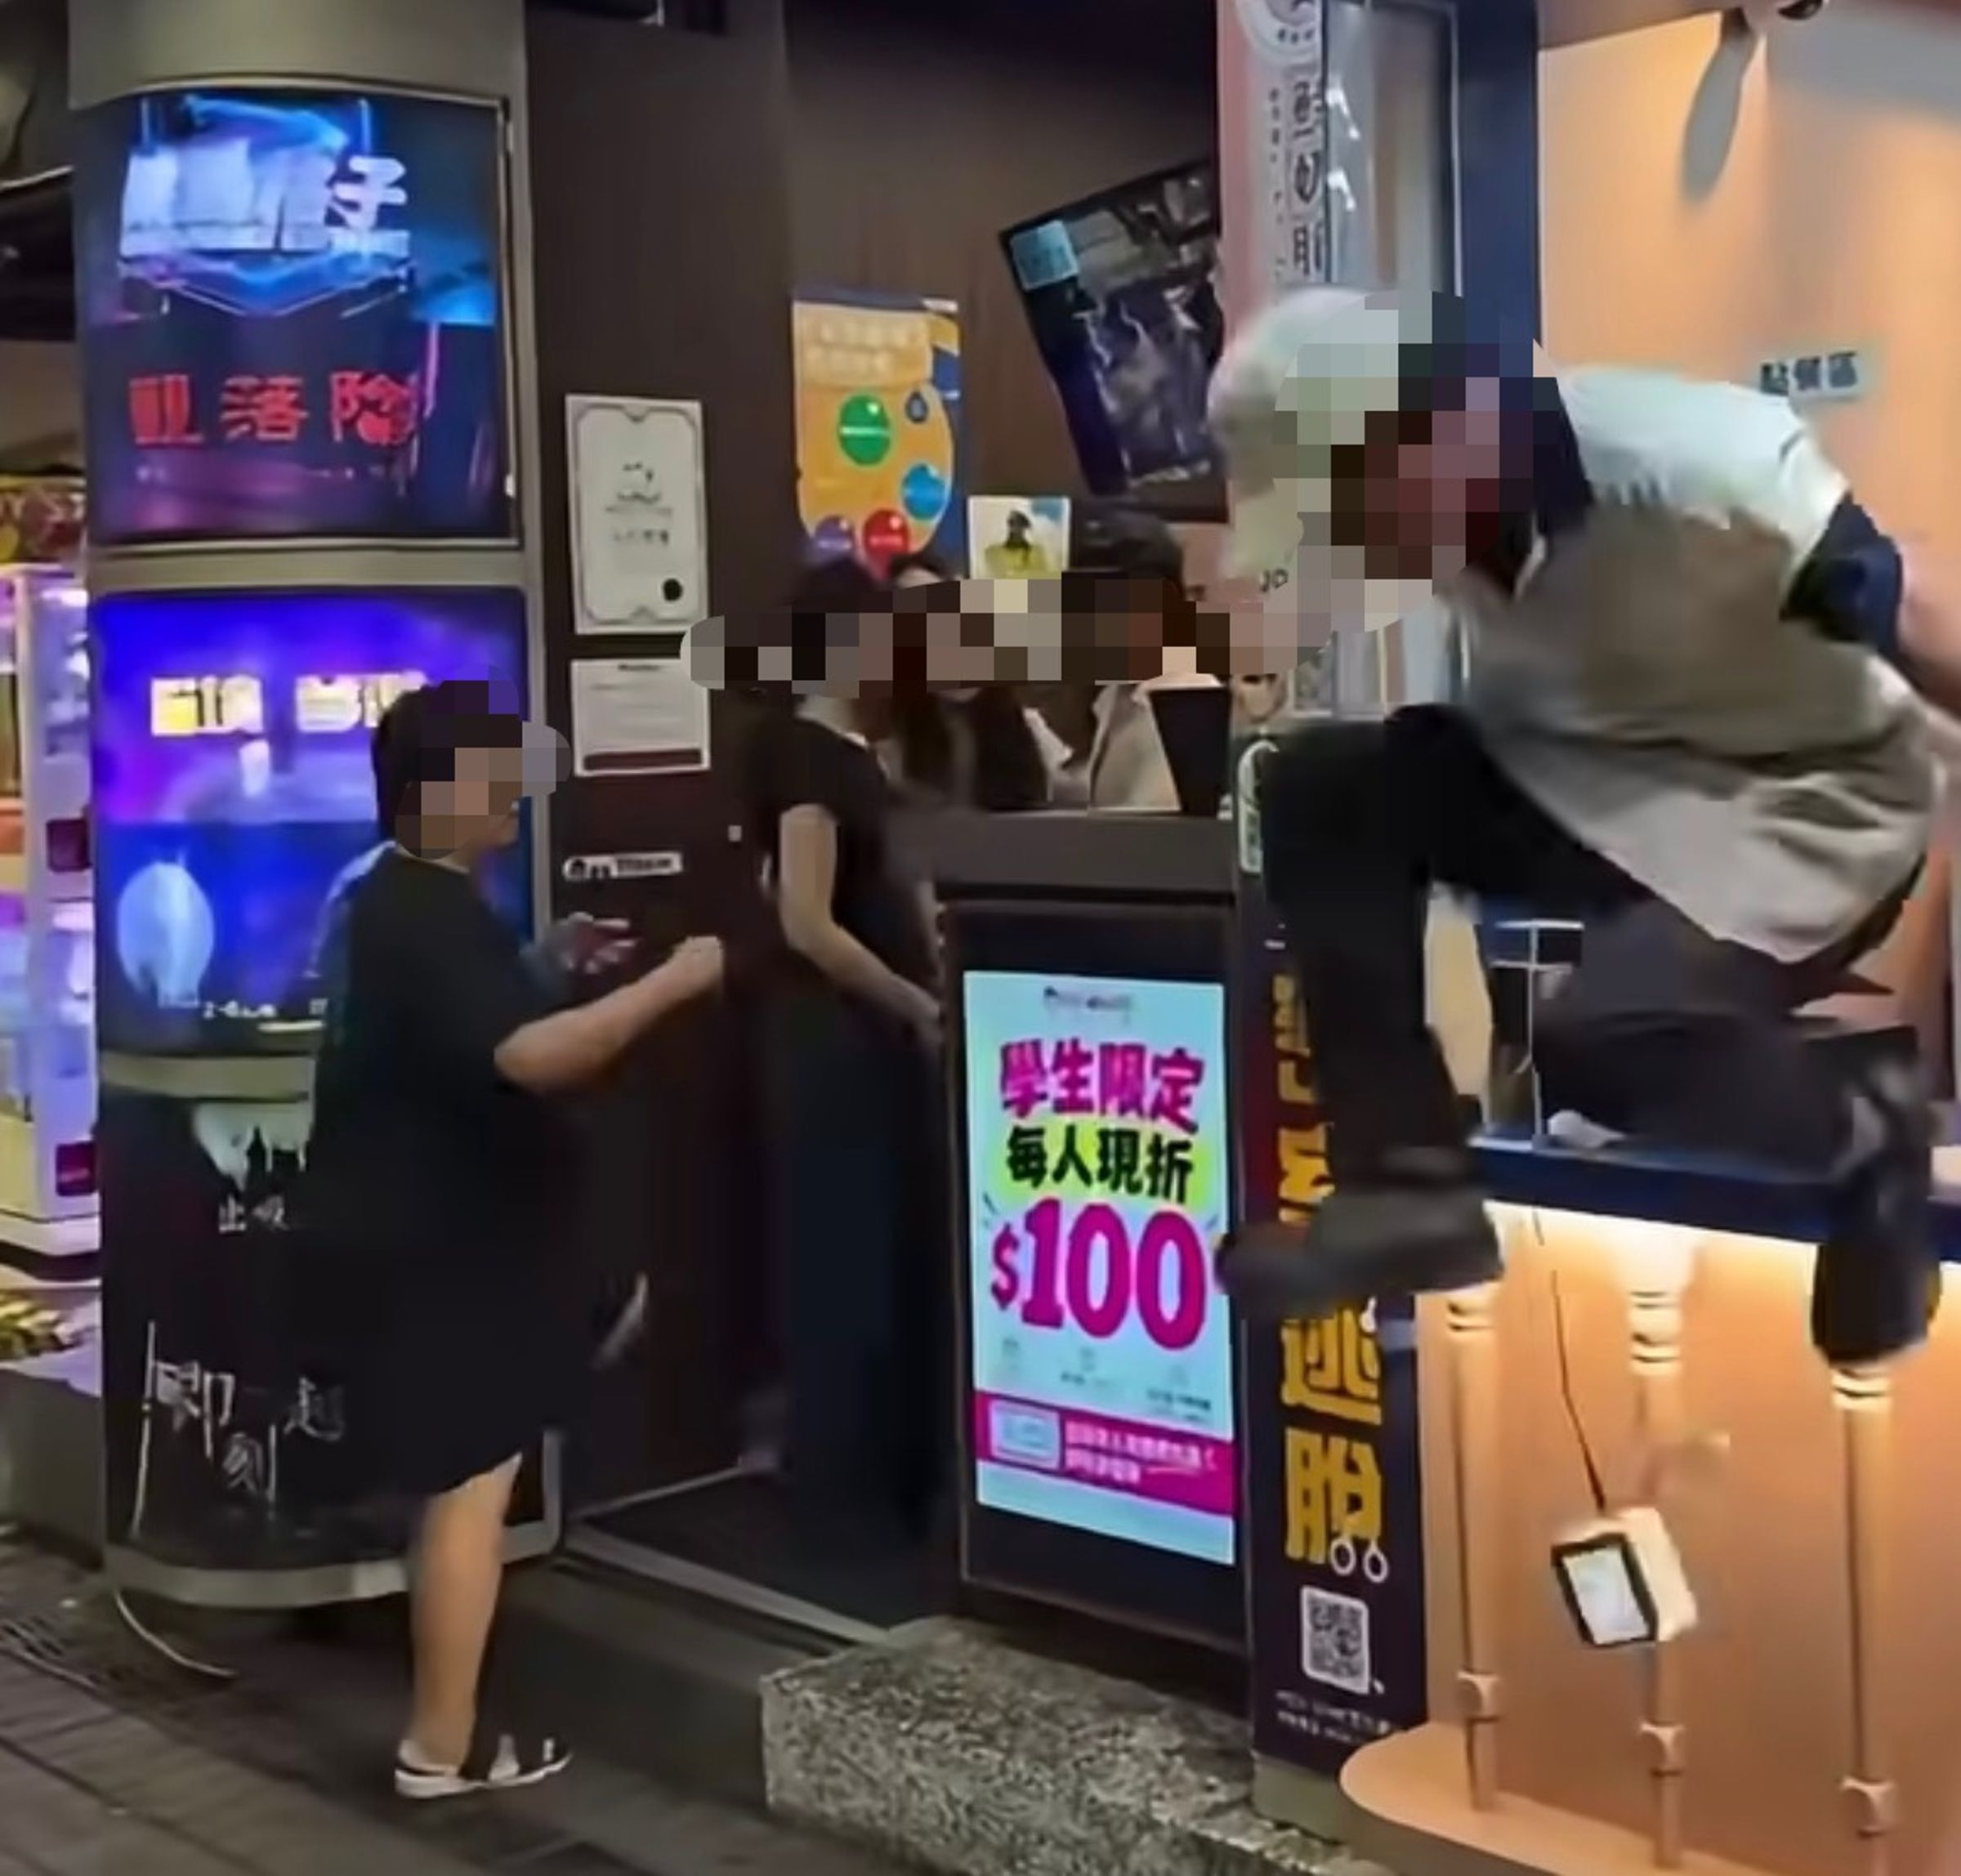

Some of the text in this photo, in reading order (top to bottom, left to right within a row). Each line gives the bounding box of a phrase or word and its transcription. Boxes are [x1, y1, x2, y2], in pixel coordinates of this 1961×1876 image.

[1000, 1038, 1204, 1134] 學生限定
[1007, 1124, 1194, 1204] 每人現折
[991, 1197, 1206, 1350] $100
